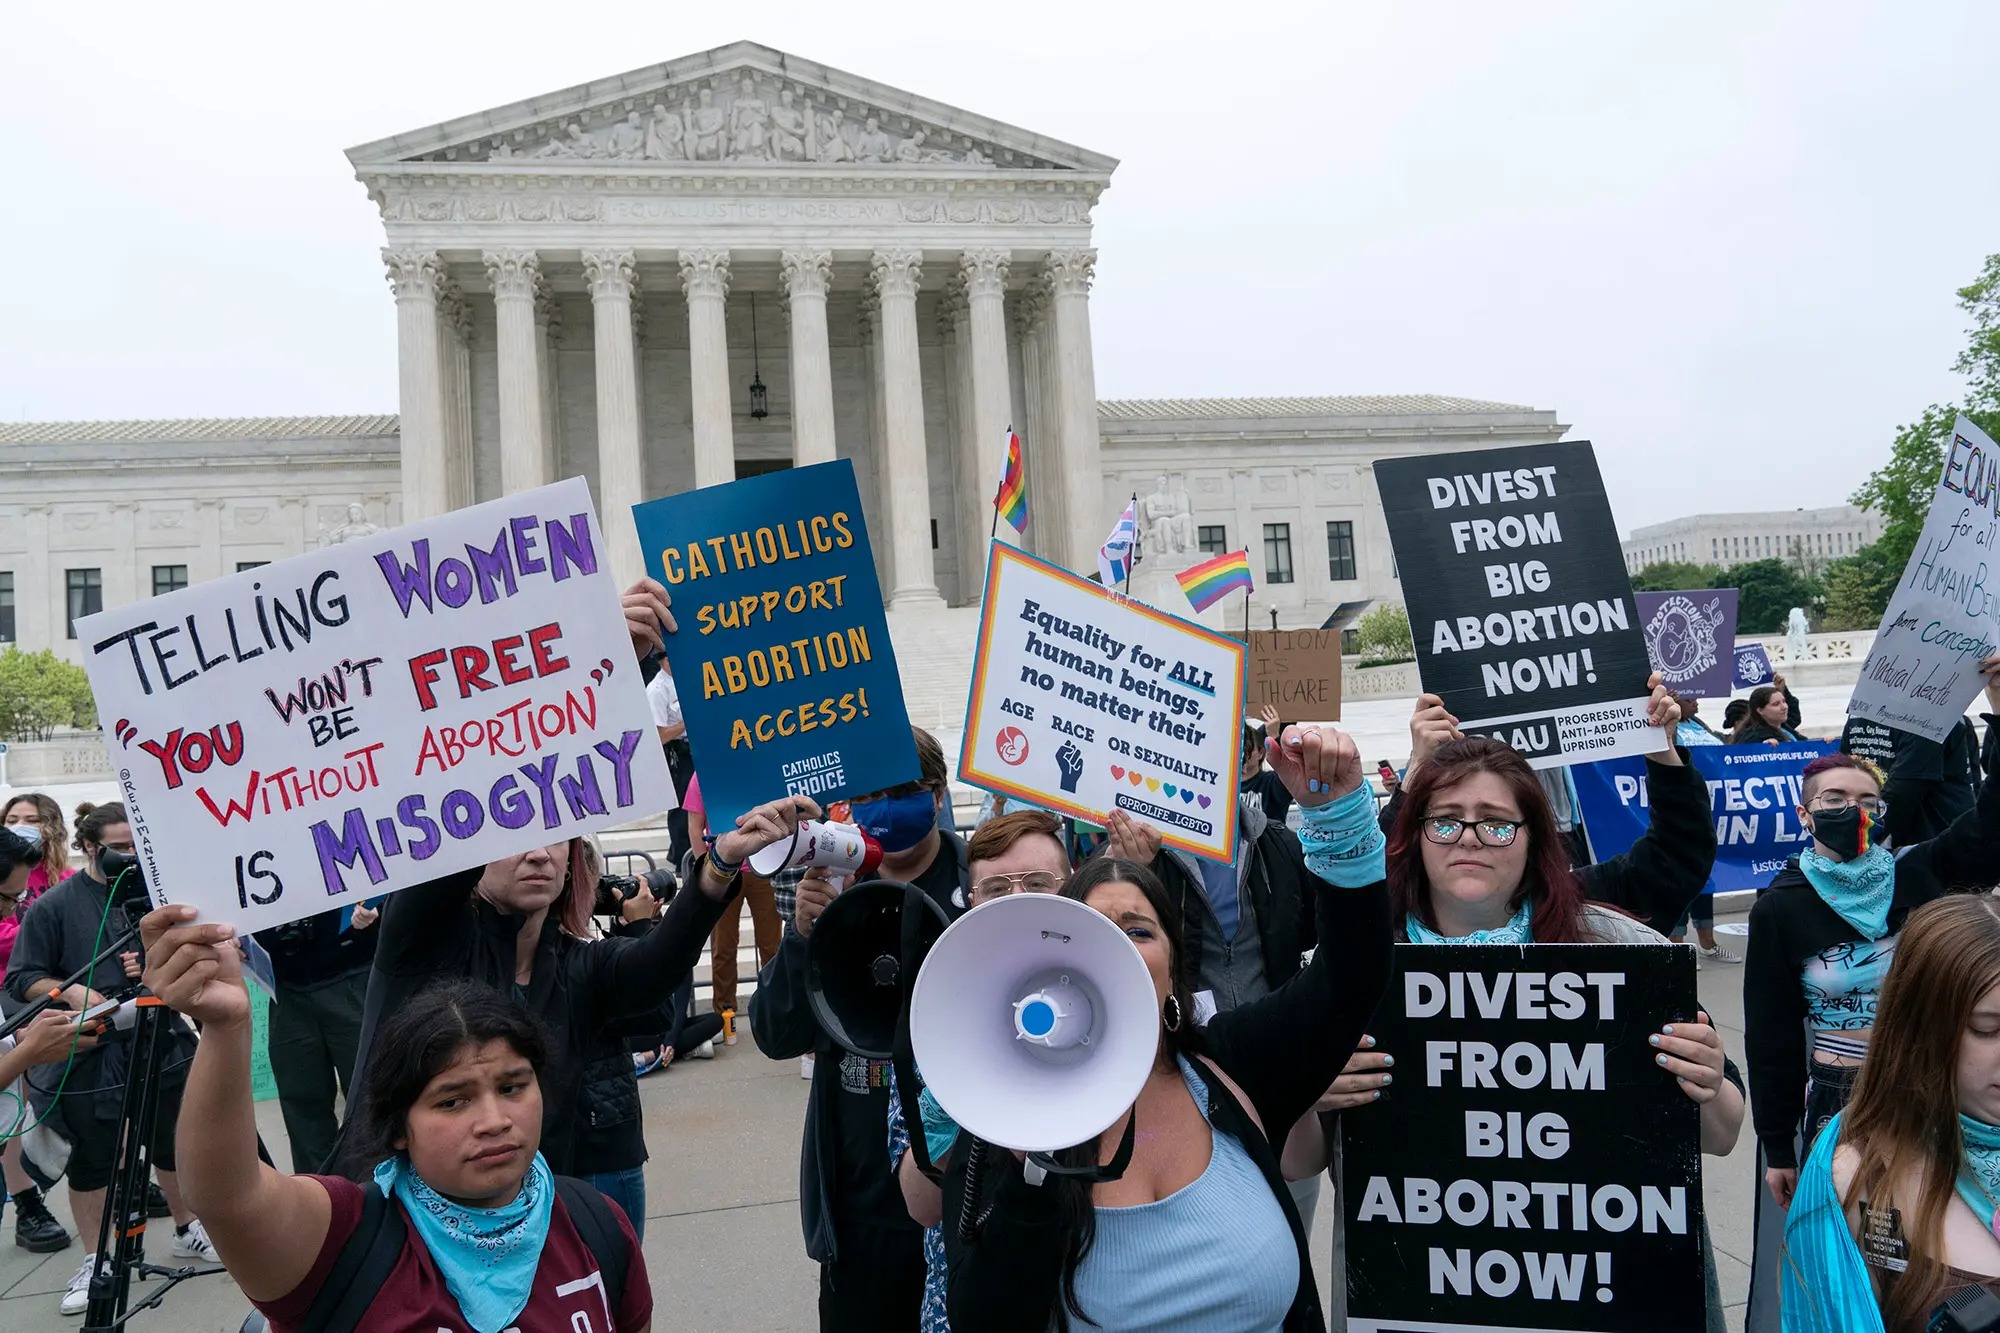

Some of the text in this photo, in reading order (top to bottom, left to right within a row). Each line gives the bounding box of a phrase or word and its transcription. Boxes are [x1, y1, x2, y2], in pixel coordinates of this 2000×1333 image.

[619, 203, 883, 218] EQUAL JUSTICE UNDER LAW
[1427, 466, 1556, 509] DIVEST
[661, 512, 854, 585] CATHOLICS
[1450, 511, 1562, 554] FROM
[1940, 508, 1996, 552] for all
[374, 513, 597, 619] WOMEN
[1484, 560, 1551, 598] BIG
[1910, 537, 1972, 605] HUMAN
[696, 574, 847, 635] SUPPORT
[1432, 598, 1629, 654] ABORTION
[1646, 596, 1702, 637] PROTECTION
[1884, 610, 1919, 637] from
[408, 622, 571, 712] FREE
[702, 626, 871, 699] ABORTION
[1020, 599, 1216, 694] Equality for ALL
[1257, 658, 1288, 675] IS
[266, 657, 383, 725] WON'T
[1025, 631, 1205, 720] human beings,
[1481, 649, 1597, 697] NOW!
[1910, 663, 1959, 706] death
[308, 705, 360, 748] BE
[730, 688, 870, 750] ACCESS!
[1020, 664, 1206, 747] no matter their
[1558, 708, 1633, 726] PROGRESSIVE
[1561, 718, 1649, 740] ANTI-ABORTION
[782, 751, 840, 777] CATHOLICS
[1000, 697, 1218, 785] AGE RACE OR SEXUALITY
[1564, 736, 1615, 752] UPRISING
[1734, 751, 1819, 764] STUDENTSFORLIFE.ORG
[787, 769, 846, 798] CHOICE
[1118, 796, 1210, 834] @PROLIFE_LGBTQ
[1717, 815, 1759, 845] IN
[234, 850, 284, 908] IS
[1752, 858, 1788, 874] justice
[1405, 972, 1625, 1020] DIVEST
[1426, 1041, 1605, 1090] FROM
[1465, 1110, 1570, 1159] BIG
[1357, 1176, 1687, 1234] ABORTION
[1429, 1247, 1613, 1303] NOW!
